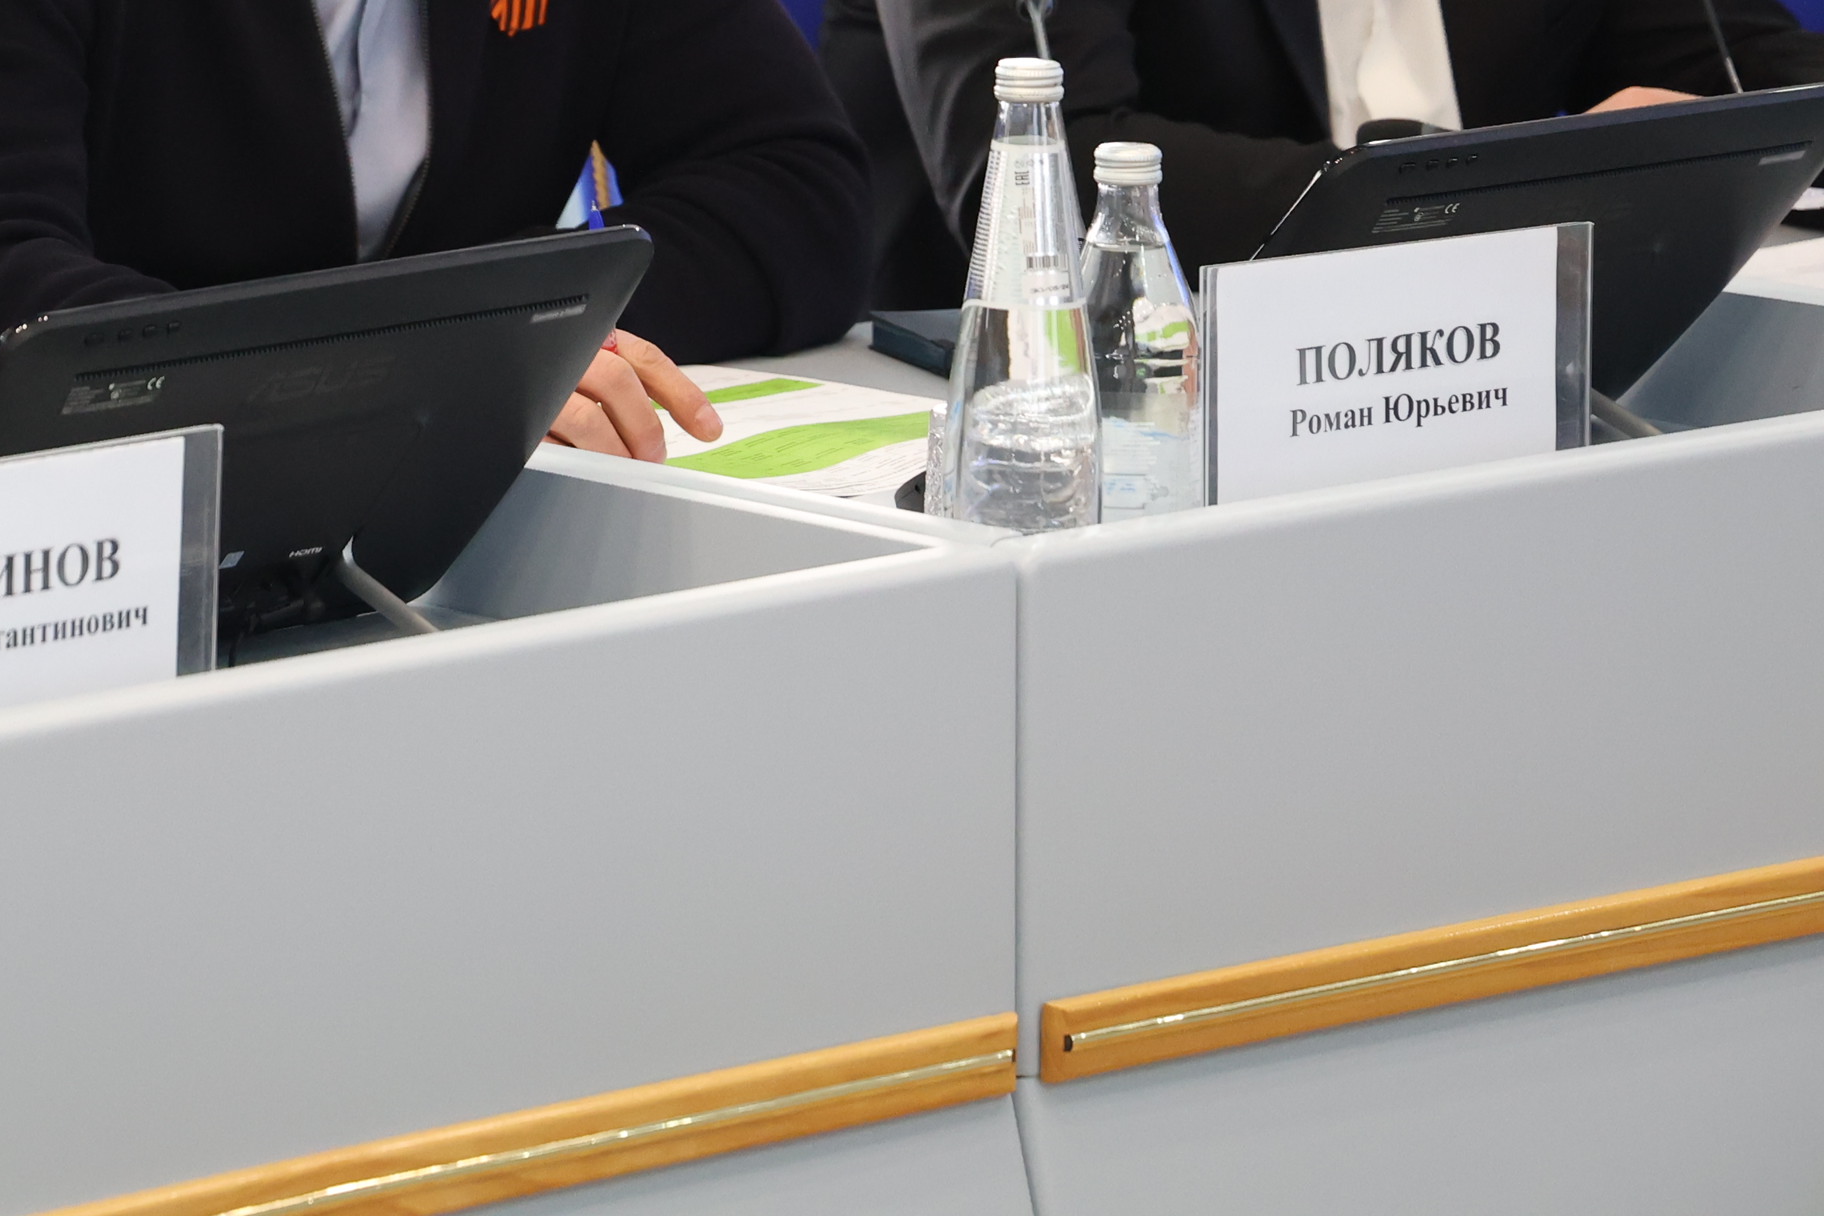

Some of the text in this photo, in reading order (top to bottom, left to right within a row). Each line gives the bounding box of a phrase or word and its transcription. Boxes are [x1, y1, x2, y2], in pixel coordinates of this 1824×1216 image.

[1295, 320, 1503, 387] ПОЛЯКОВ
[1288, 386, 1510, 439] Роман Юрьевич
